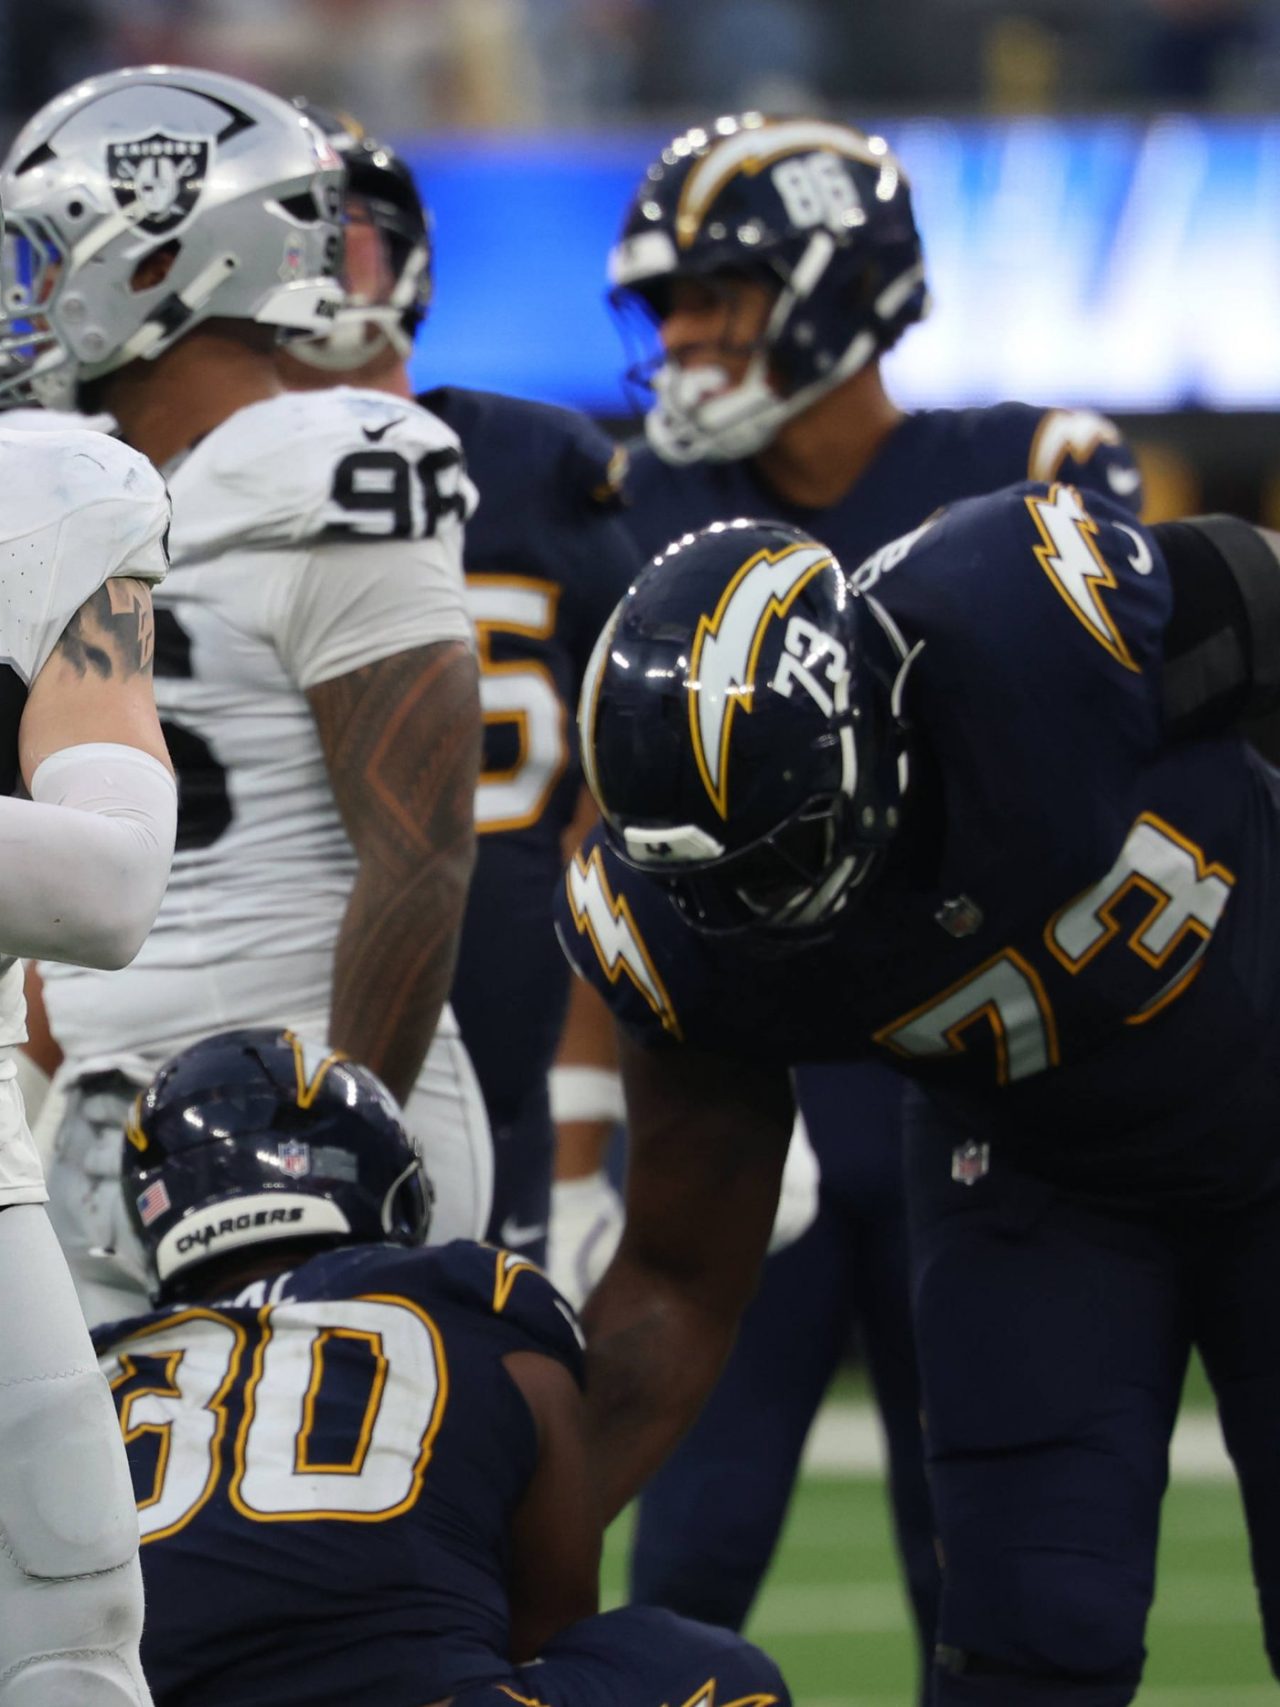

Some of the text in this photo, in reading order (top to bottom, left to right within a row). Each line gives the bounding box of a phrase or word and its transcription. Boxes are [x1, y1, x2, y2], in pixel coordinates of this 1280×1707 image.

[772, 614, 848, 718] 73
[872, 809, 1237, 1086] 73
[175, 1207, 305, 1254] CHARGERS
